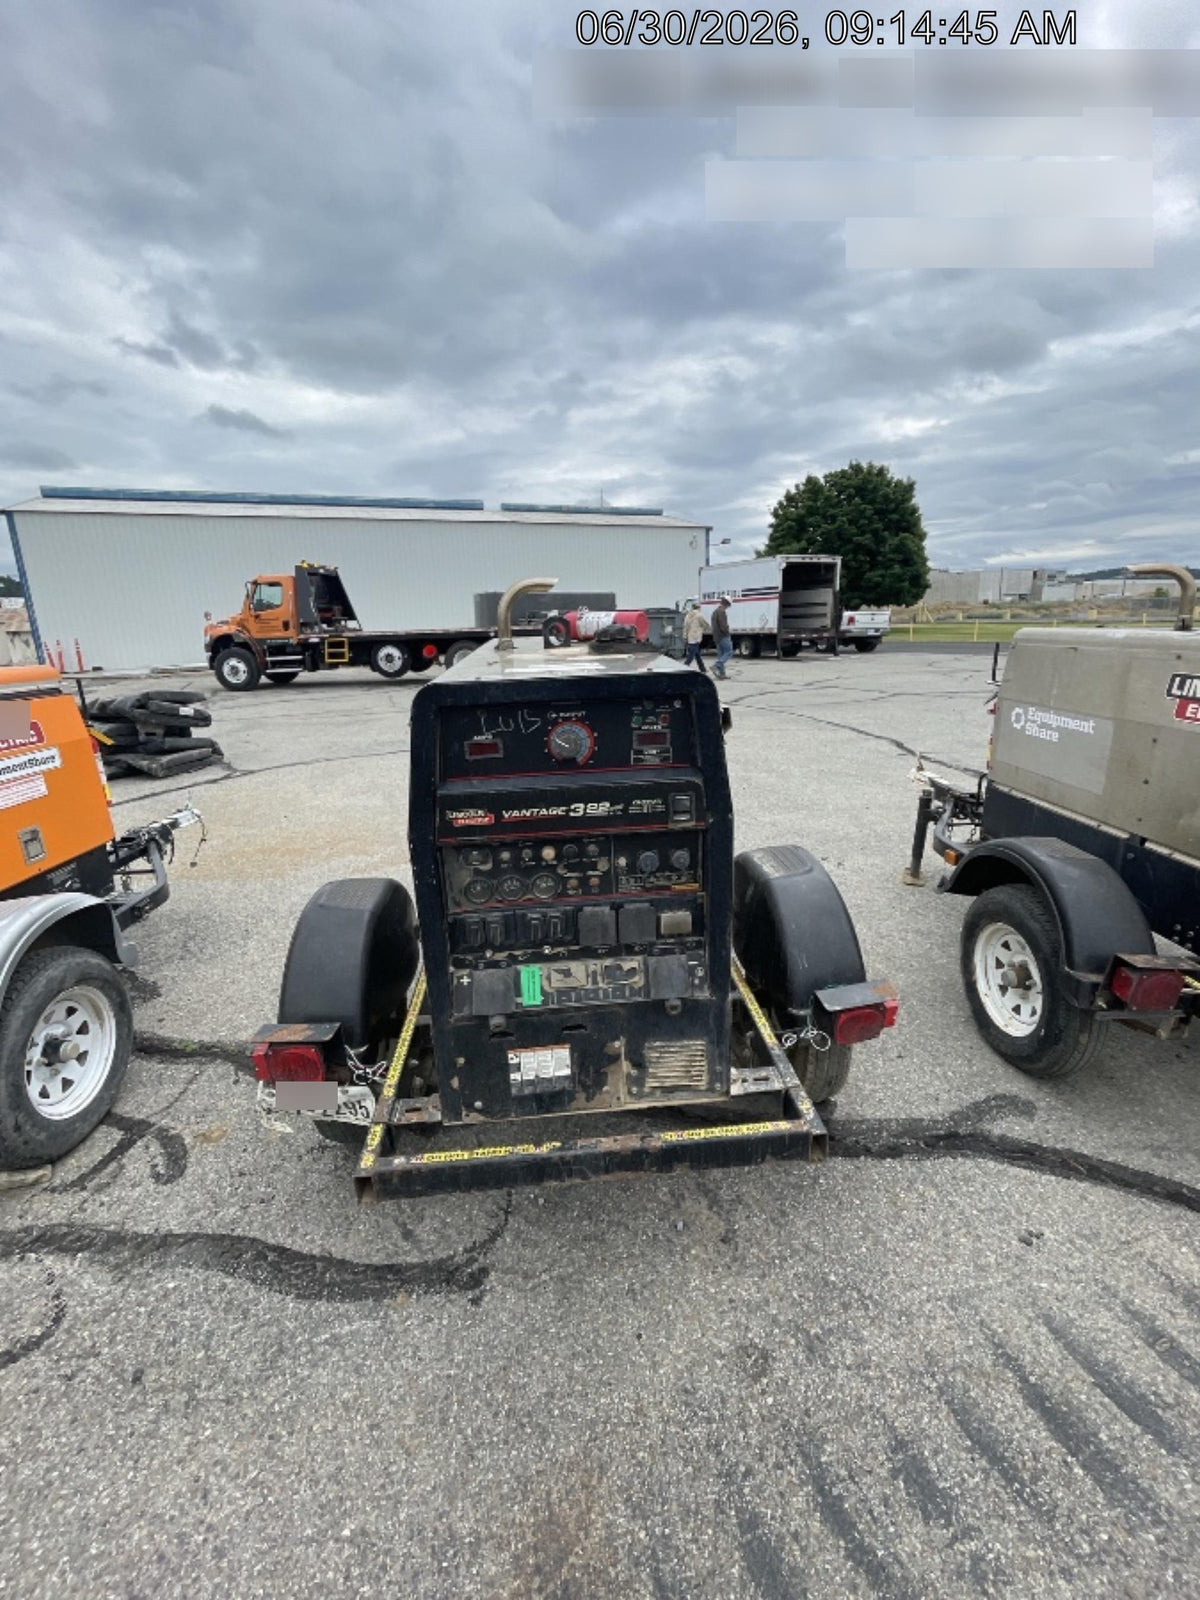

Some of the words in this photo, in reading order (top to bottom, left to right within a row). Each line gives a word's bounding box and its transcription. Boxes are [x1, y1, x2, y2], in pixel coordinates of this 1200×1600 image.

[1025, 721, 1059, 743] Share
[1026, 707, 1096, 735] Equipment
[502, 806, 569, 818] VANTAGE
